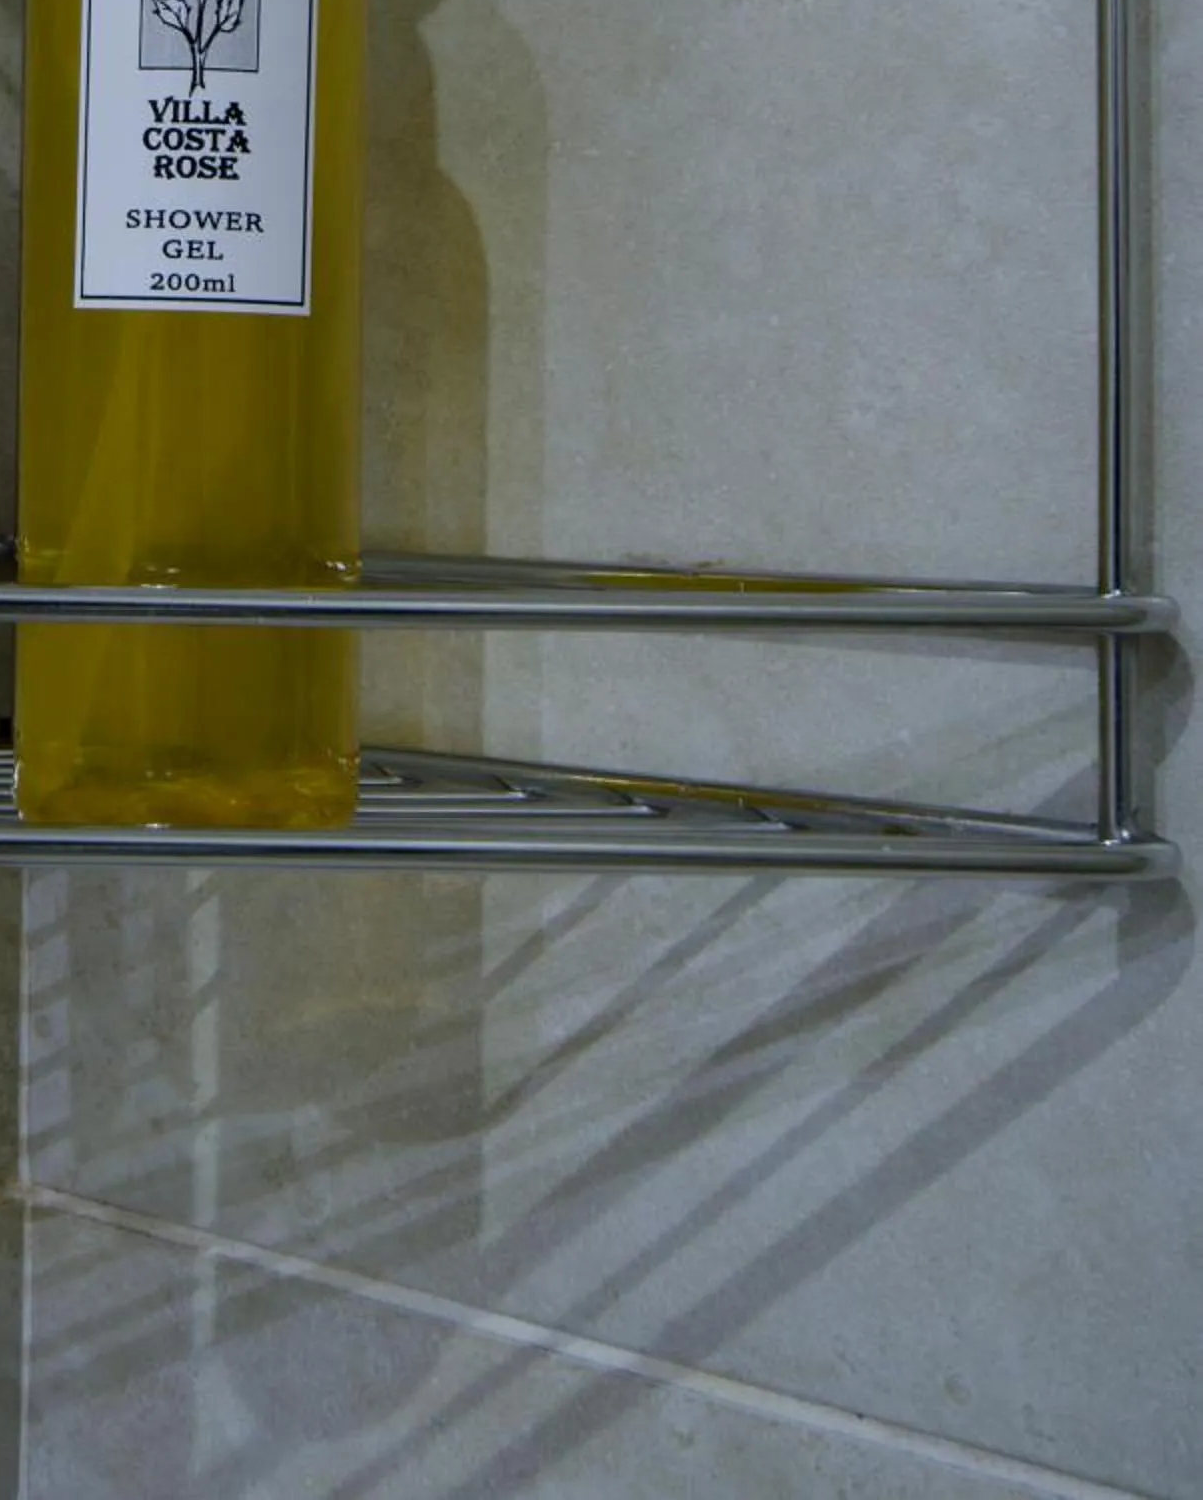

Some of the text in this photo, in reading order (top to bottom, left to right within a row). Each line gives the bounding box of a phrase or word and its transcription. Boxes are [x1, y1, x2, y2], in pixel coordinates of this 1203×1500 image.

[147, 97, 247, 126] VILLA
[142, 127, 251, 154] COSTA
[152, 155, 239, 180] ROSE
[125, 208, 264, 233] SHOWER
[161, 239, 224, 261] GEL
[149, 273, 236, 293] 200ml
